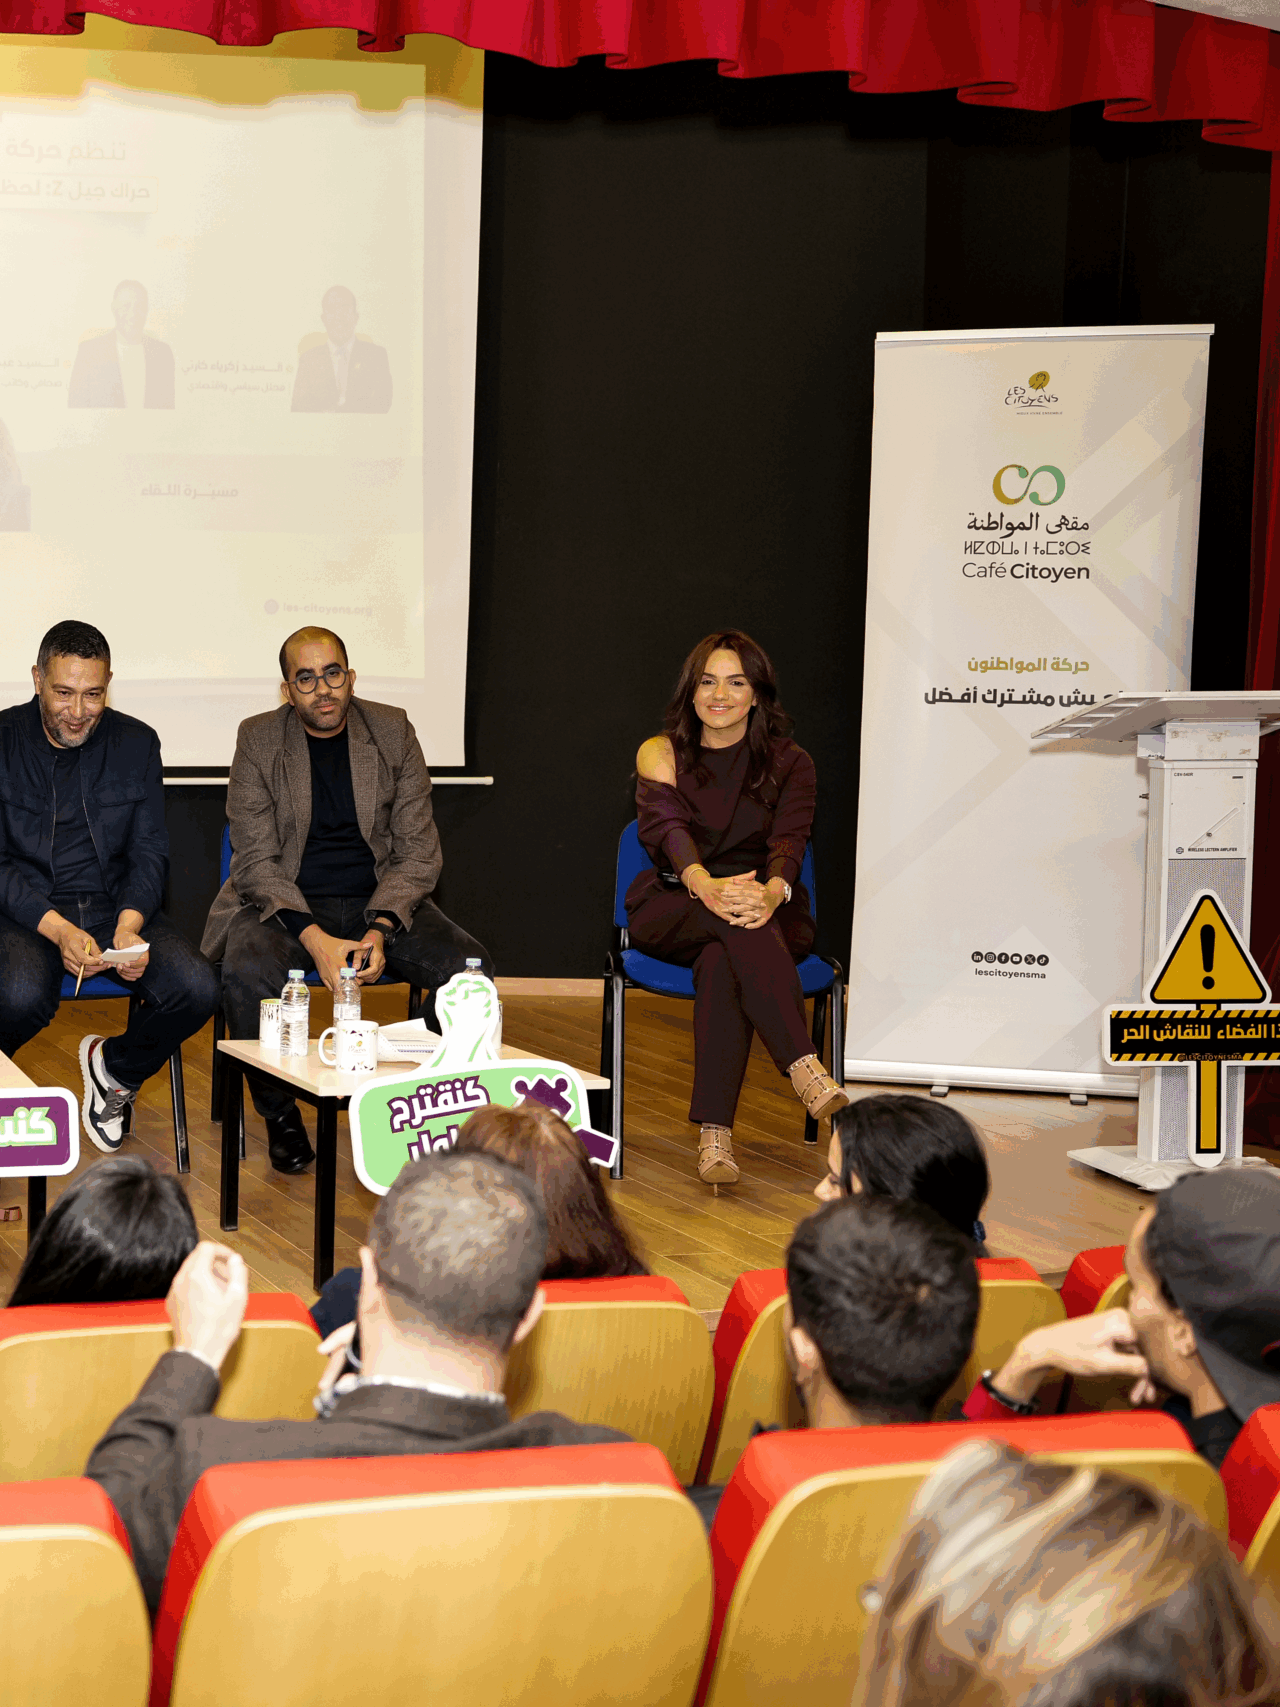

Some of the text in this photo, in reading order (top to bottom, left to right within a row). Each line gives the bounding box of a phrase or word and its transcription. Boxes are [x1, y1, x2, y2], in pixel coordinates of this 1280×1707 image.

[1008, 386, 1026, 396] LES
[967, 512, 1090, 539] مقهى المواطنة
[962, 561, 1090, 583] Café Citoyen
[967, 656, 1090, 675] حركة المواطنون
[924, 686, 978, 705] أفضل
[982, 687, 1056, 708] مشترك
[974, 968, 1047, 979] lescitoyensma
[1121, 1024, 1150, 1044] الحر
[1152, 1023, 1211, 1042] للنقاش
[1217, 1023, 1268, 1040] الفضاء
[387, 1075, 491, 1133] كنقترح
